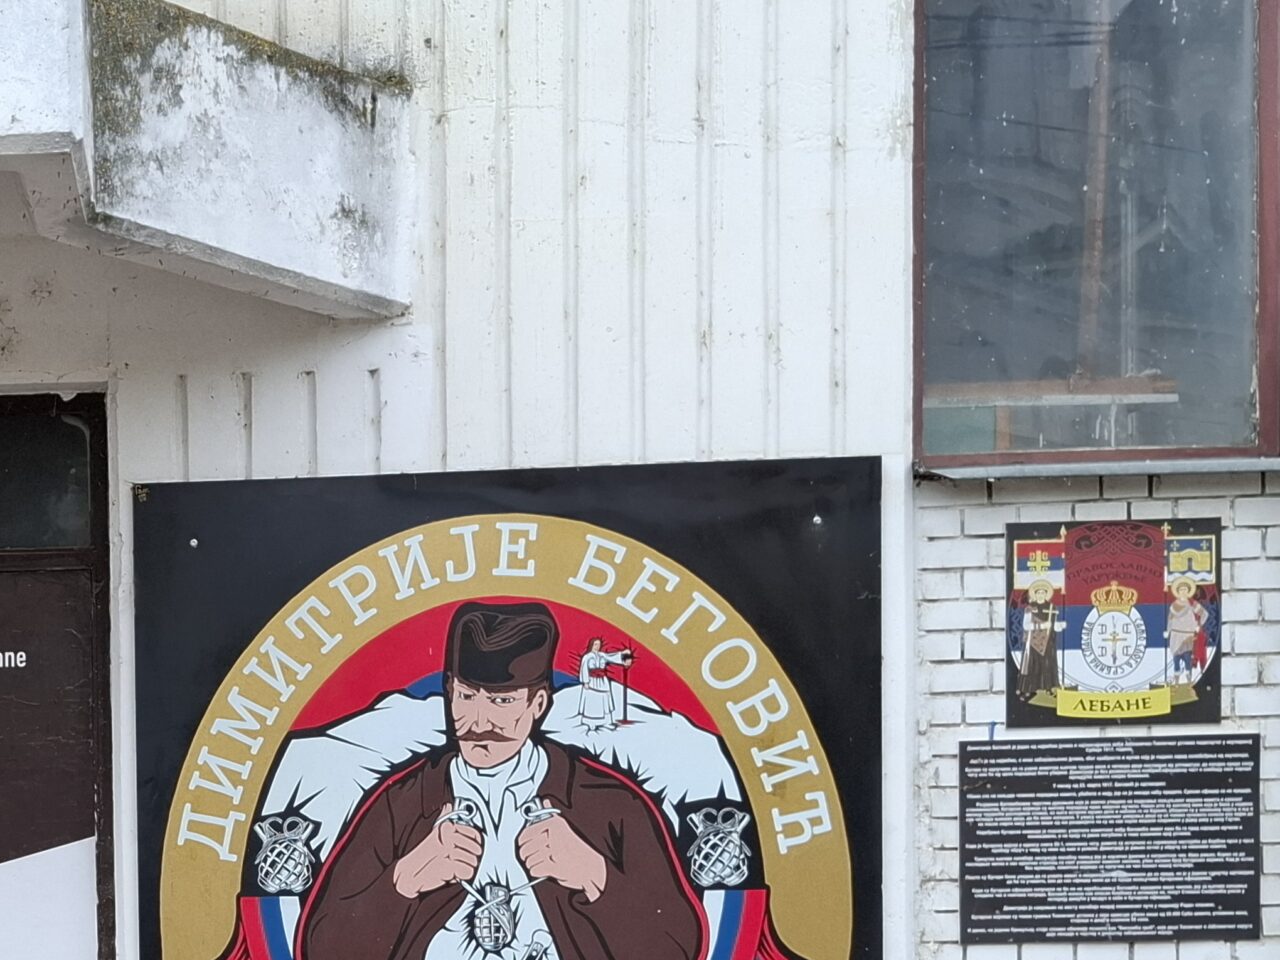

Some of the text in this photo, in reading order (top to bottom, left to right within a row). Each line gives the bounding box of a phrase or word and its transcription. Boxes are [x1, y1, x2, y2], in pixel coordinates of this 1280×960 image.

[177, 521, 832, 862] ДИМИТРИЈЕ БЕГОВИЋ
[1073, 696, 1153, 712] ЛЕБАНЕ
